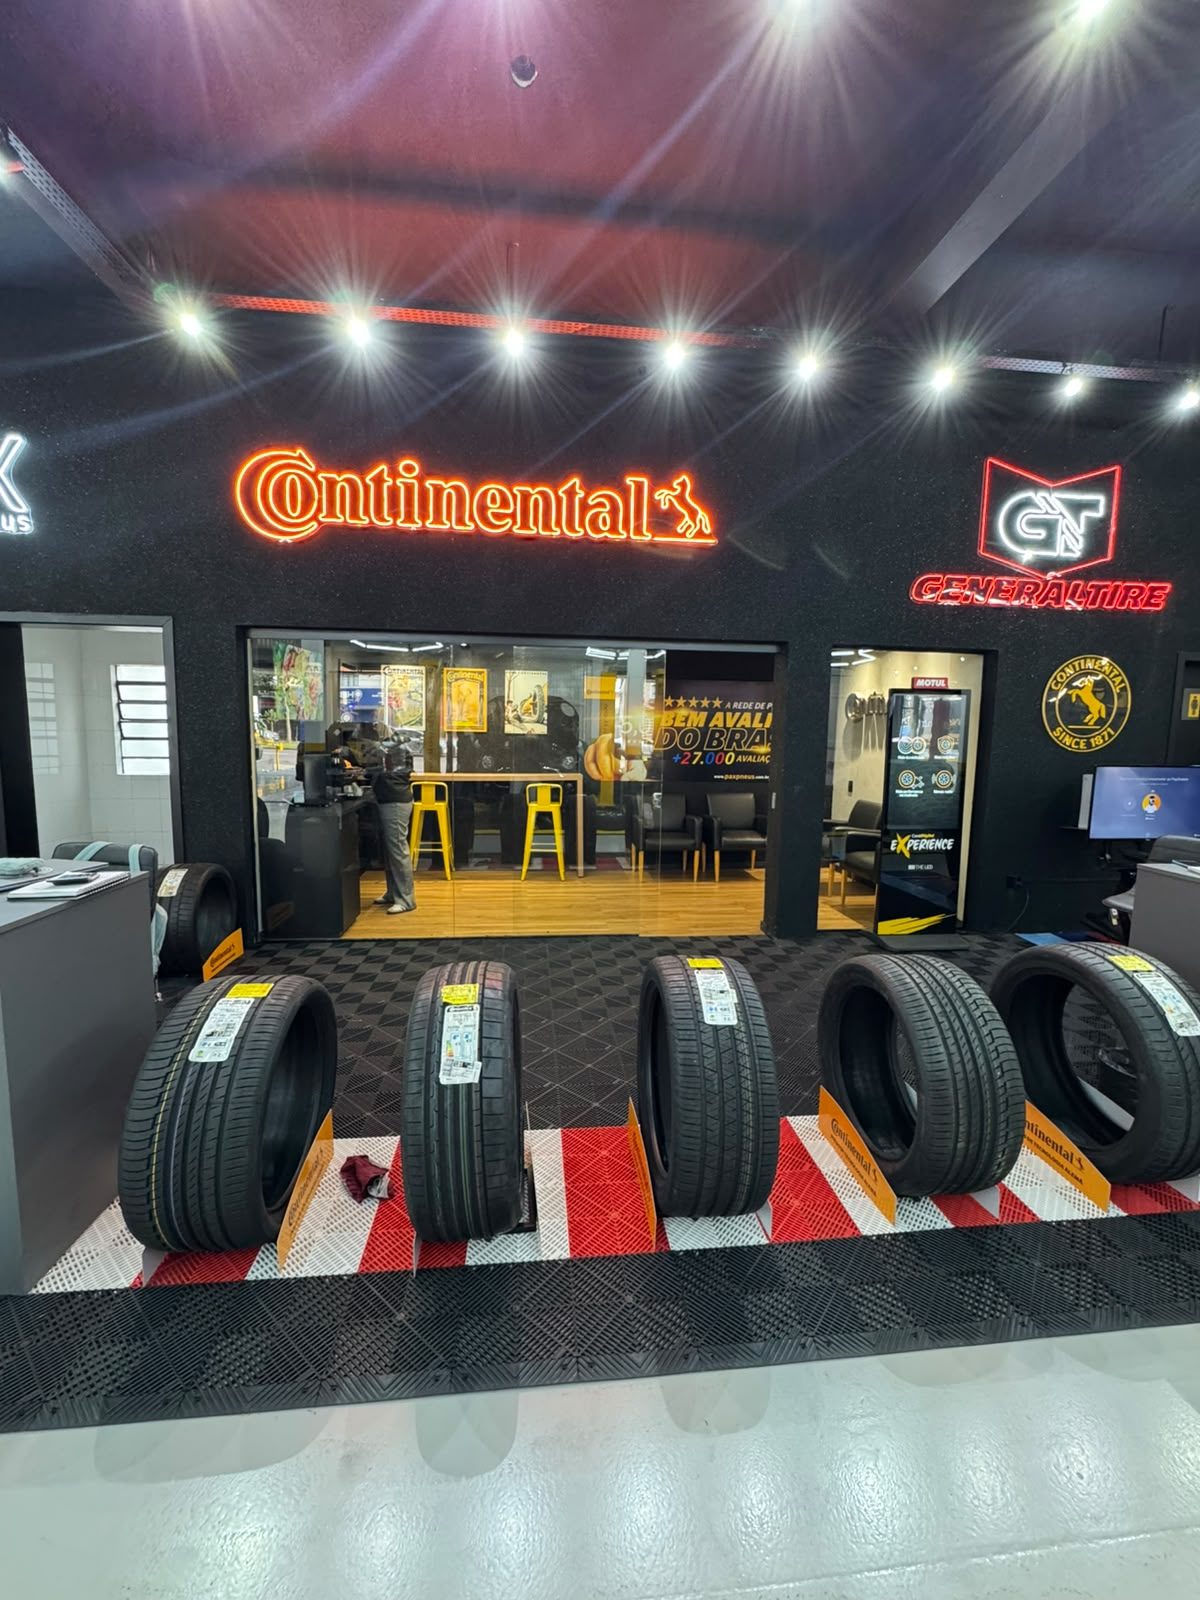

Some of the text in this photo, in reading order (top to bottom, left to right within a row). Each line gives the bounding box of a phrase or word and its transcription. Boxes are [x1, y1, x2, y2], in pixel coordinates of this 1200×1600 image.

[235, 447, 653, 543] Continental
[916, 679, 946, 687] MOTUL
[1050, 658, 1127, 693] CONTINENTAL
[732, 702, 754, 710] REDE
[754, 702, 766, 710] DE
[660, 711, 709, 728] BEM
[653, 727, 772, 751] DO BRA
[1053, 726, 1115, 749] SINCE 1871
[672, 751, 735, 765] +27.000
[831, 1118, 872, 1175] Continental
[1025, 1120, 1074, 1164] ntinental
